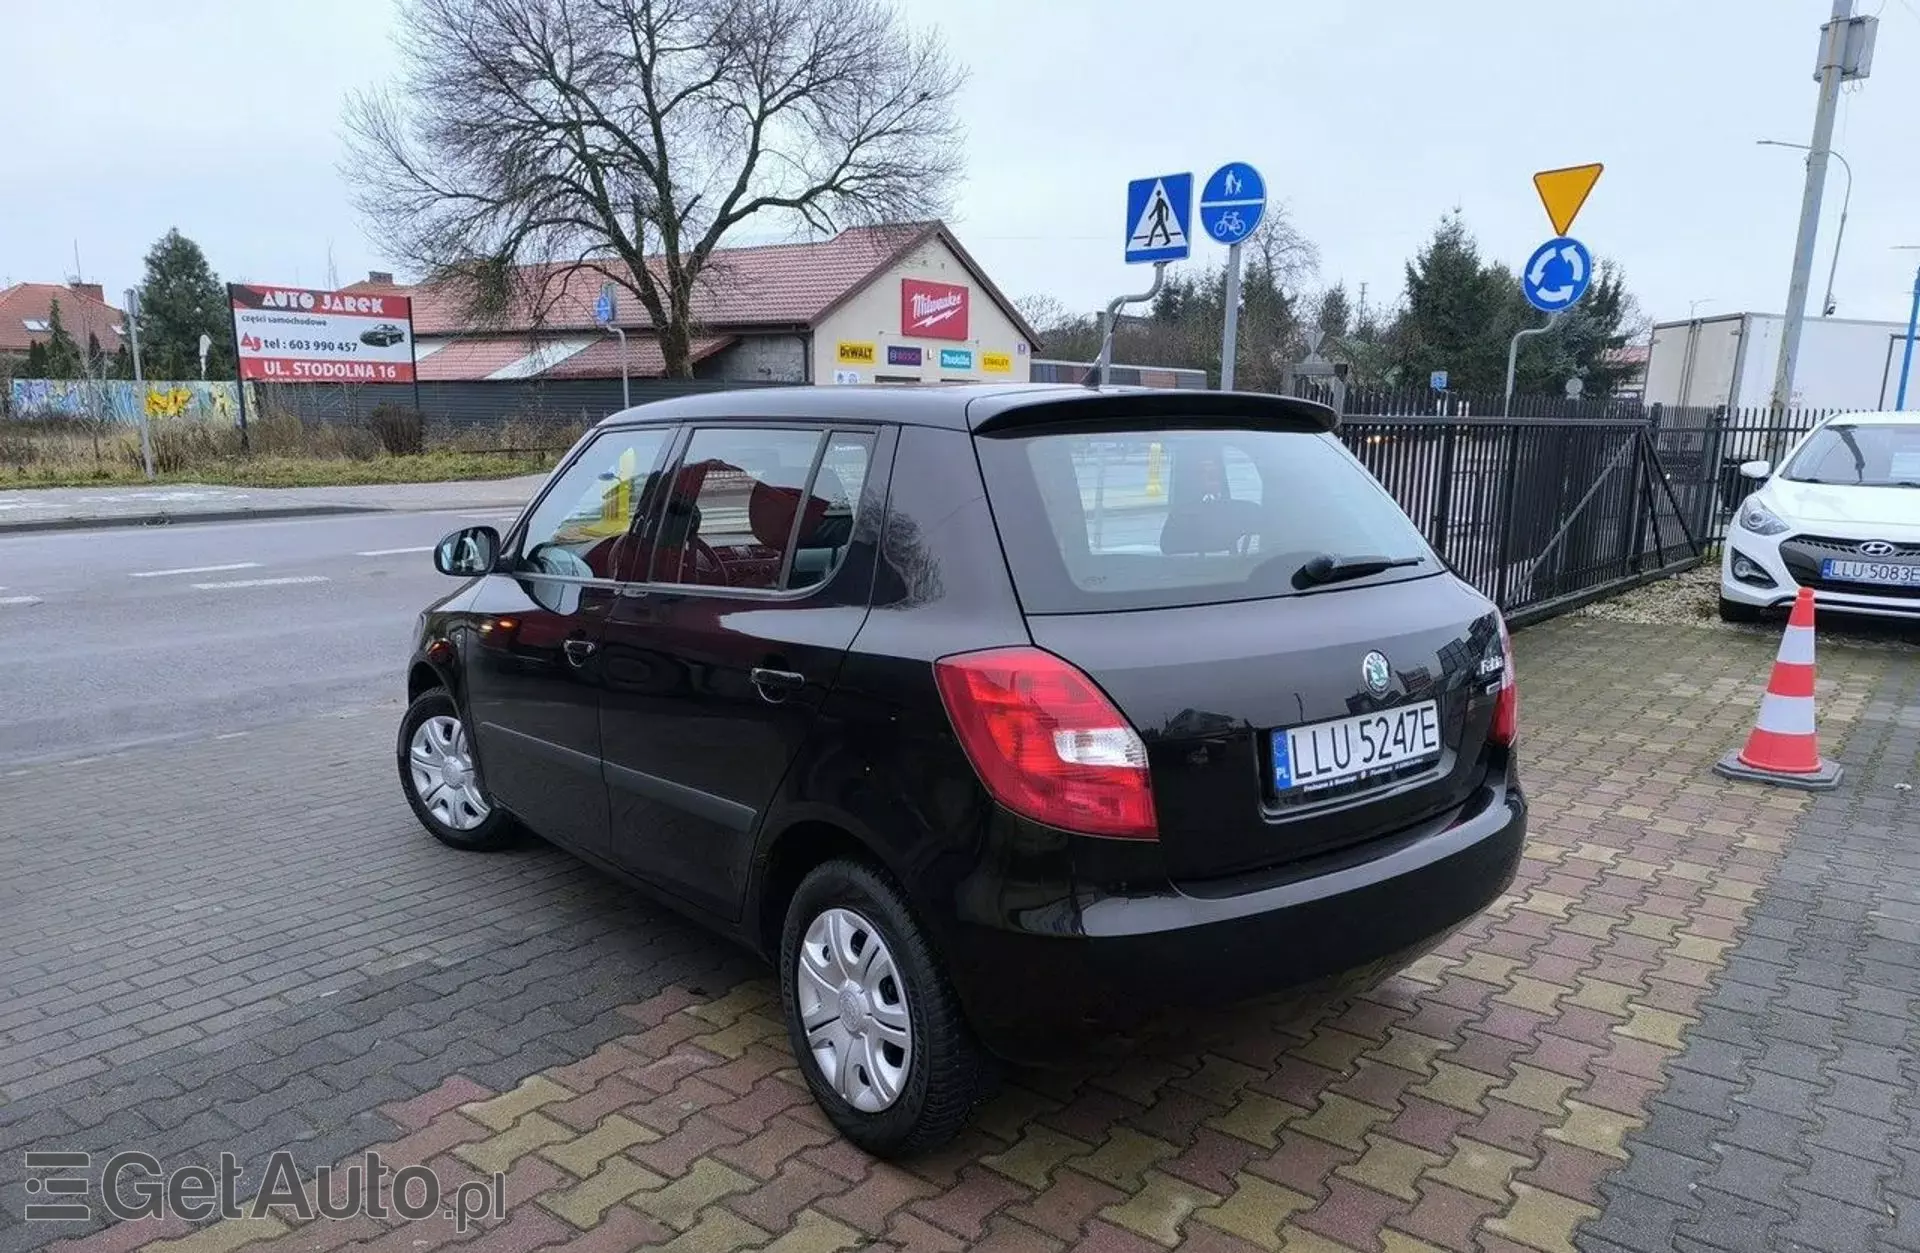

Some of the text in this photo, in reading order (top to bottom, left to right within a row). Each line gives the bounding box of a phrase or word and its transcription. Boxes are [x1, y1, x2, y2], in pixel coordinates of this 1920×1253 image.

[262, 290, 384, 314] AUTO JAREK
[911, 291, 962, 319] Milwaukee
[268, 316, 327, 327] samochodowe
[289, 339, 311, 351] 603
[313, 340, 335, 352] 990
[337, 341, 358, 352] 457
[263, 360, 396, 379] UL. STODOLNA 16
[1832, 562, 1864, 578] LLU
[1869, 563, 1920, 582] 5083E
[1291, 723, 1351, 780] LLU
[1359, 705, 1437, 764] 5247E
[1276, 767, 1290, 780] PL
